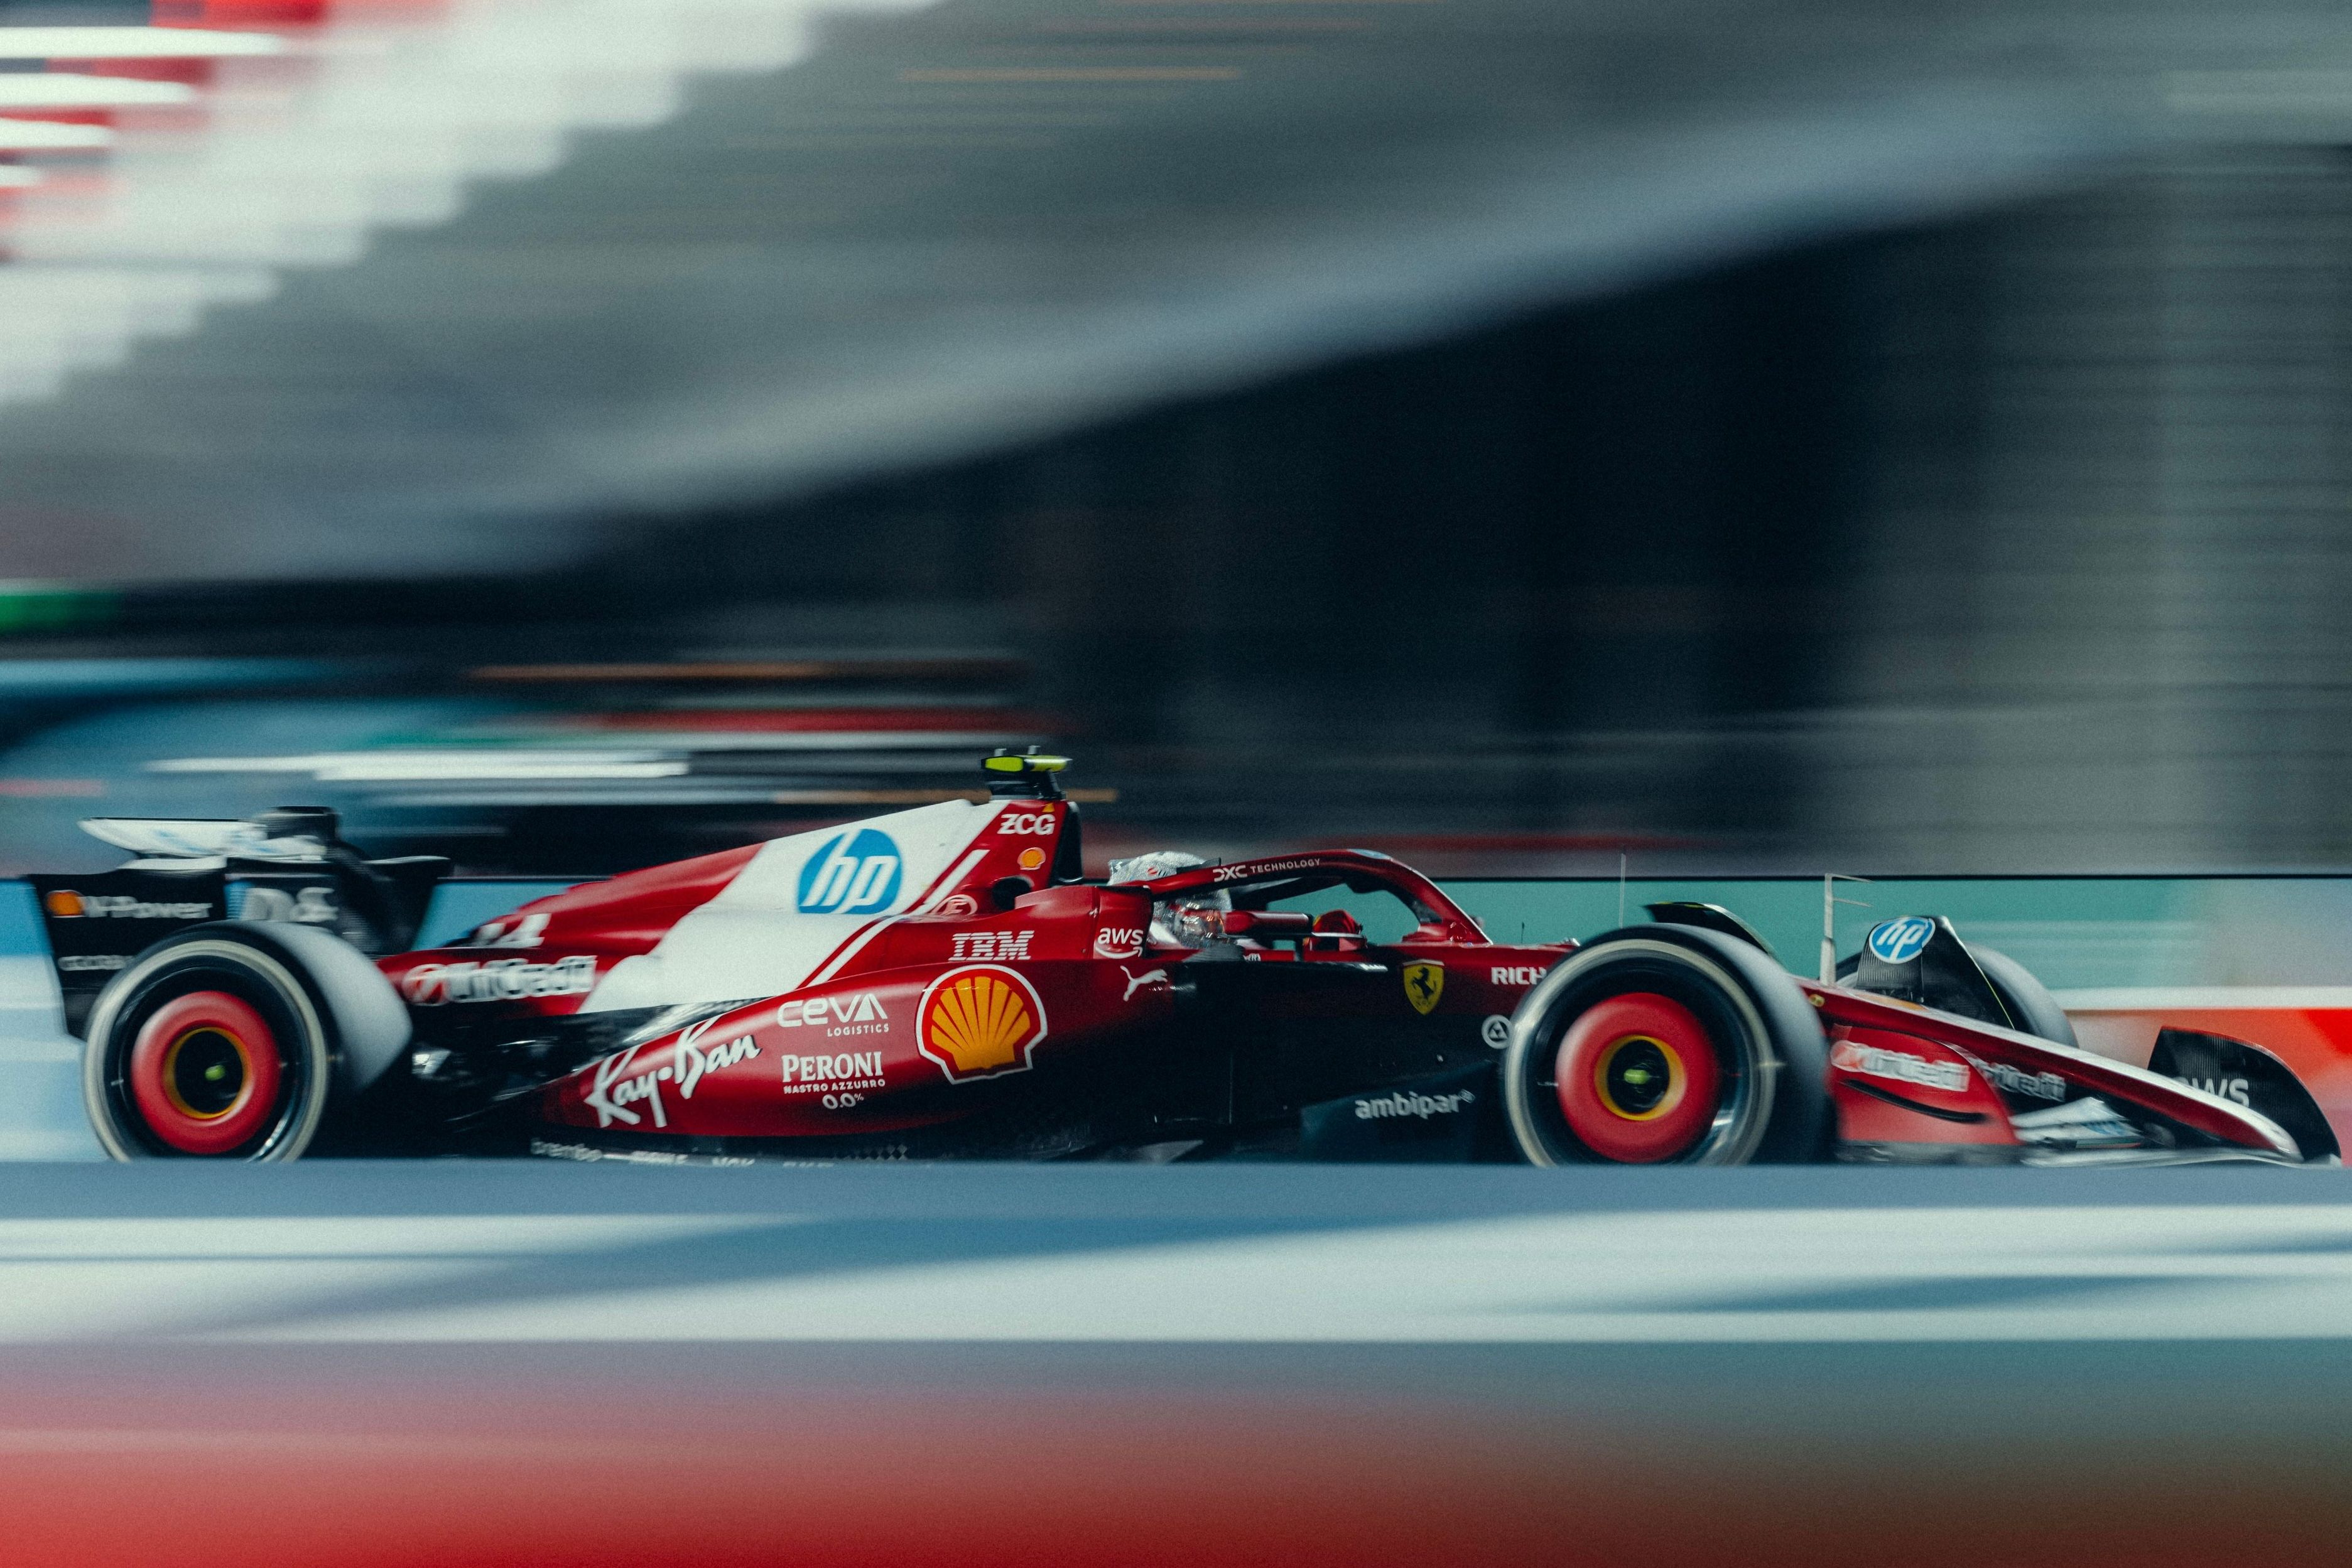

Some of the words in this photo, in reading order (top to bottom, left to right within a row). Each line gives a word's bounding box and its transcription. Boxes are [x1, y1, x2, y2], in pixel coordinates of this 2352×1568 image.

[997, 813, 1056, 835] ZCG
[799, 829, 902, 914] hp
[1212, 865, 1248, 882] DXC
[1250, 858, 1320, 874] TECHNOLOGY
[948, 930, 1035, 961] IBM
[1097, 927, 1144, 946] aws
[827, 1023, 889, 1037] LOGISTICS
[783, 1083, 828, 1094] NASTRO
[832, 1079, 886, 1091] AZZURRO
[822, 1093, 864, 1110] 0.0%
[1355, 1091, 1462, 1120] ambipar
